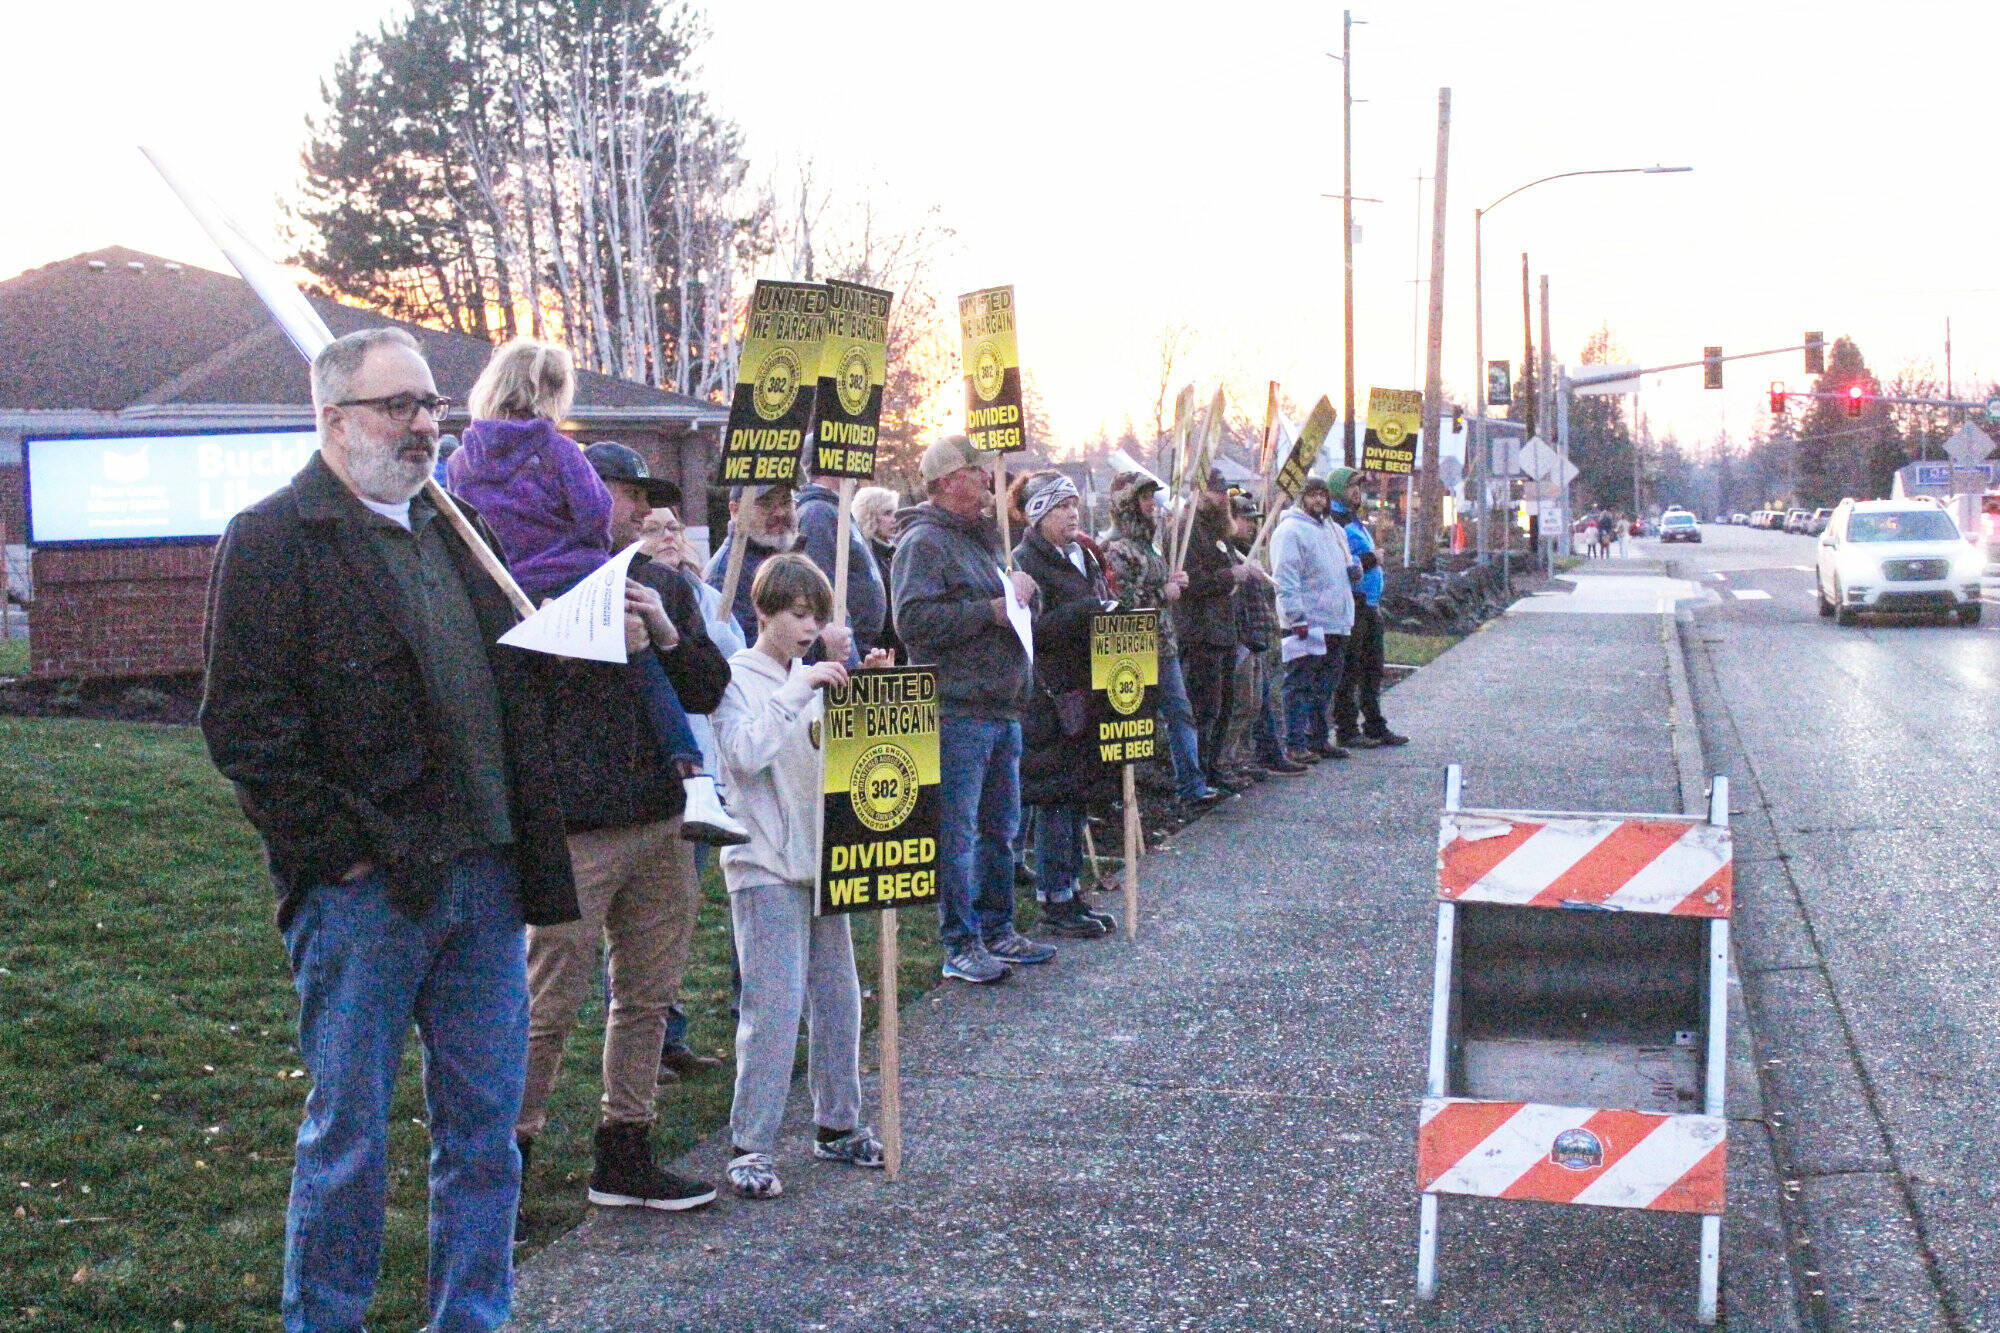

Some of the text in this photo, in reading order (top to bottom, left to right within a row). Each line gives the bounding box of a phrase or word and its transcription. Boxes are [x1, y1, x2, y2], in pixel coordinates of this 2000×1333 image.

[757, 284, 829, 315] UNITED
[829, 284, 889, 318] UNITED
[959, 289, 1012, 317] UNITED
[753, 313, 826, 342] WE BARGAIN
[828, 311, 887, 342] WE BARGAIN
[961, 311, 1014, 339] WE BARGAIN
[768, 377, 787, 394] 382
[849, 374, 864, 391] 382
[968, 404, 1020, 429] DIVIDED
[731, 429, 801, 451] DIVIDED
[821, 421, 876, 446] DIVIDED
[968, 427, 1021, 450] WE BEG!
[198, 439, 307, 478] Buckl
[818, 448, 873, 473] WE BEG!
[1365, 459, 1412, 474] WE BEG!
[1366, 447, 1413, 461] DIVIDED
[725, 457, 797, 480] WE BEG!
[1095, 614, 1156, 635] UNITED
[1095, 633, 1155, 656] WE BARGAIN
[830, 673, 935, 707] UNITED
[1119, 681, 1134, 694] 382
[830, 703, 936, 739] WE BARGAIN
[1100, 718, 1154, 740] DIVIDED
[1100, 739, 1154, 762] WE BEG!
[853, 747, 883, 787] OPERATING
[885, 747, 916, 782] ENGINEERS
[871, 778, 898, 799] 382
[853, 793, 890, 829] WASHINGTON
[898, 787, 917, 821] ALASKA
[831, 836, 936, 872] DIVIDED
[829, 869, 936, 906] WE BEG!
